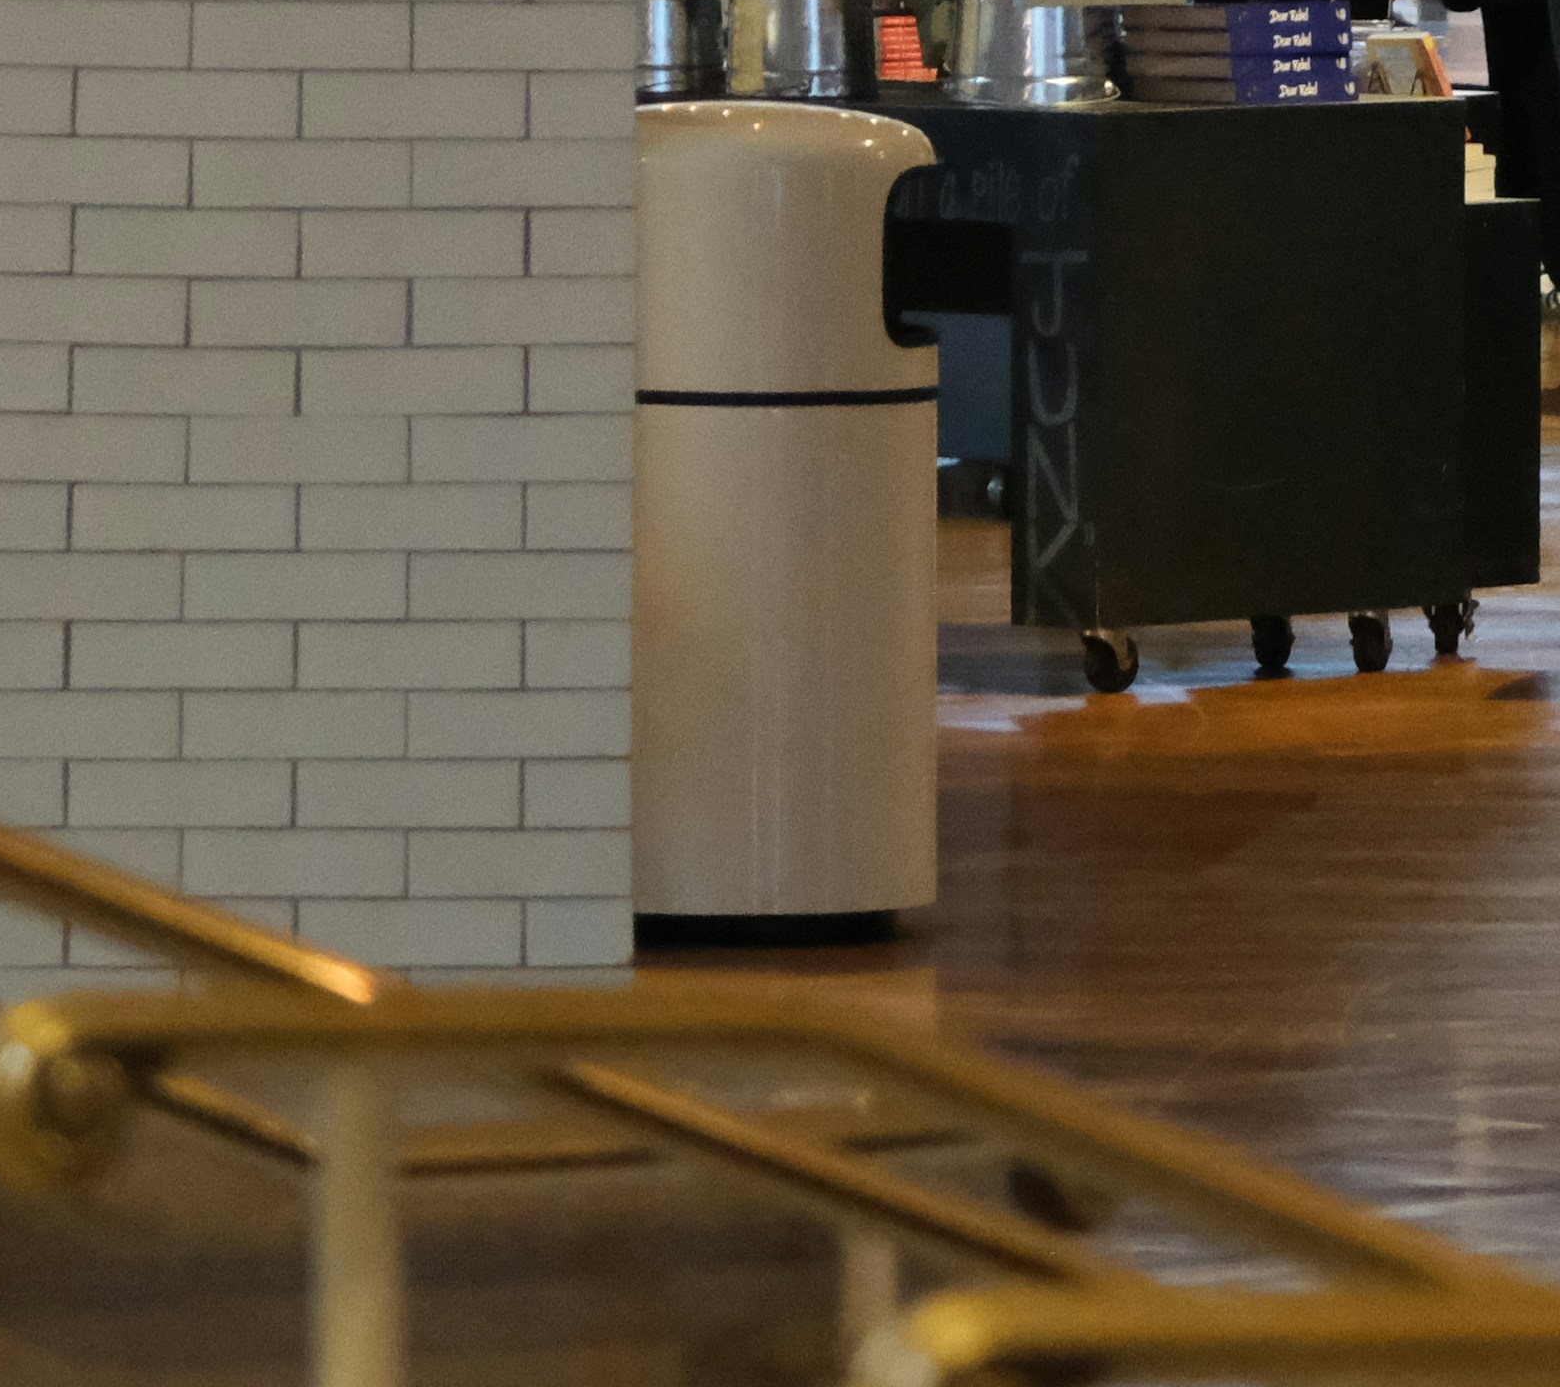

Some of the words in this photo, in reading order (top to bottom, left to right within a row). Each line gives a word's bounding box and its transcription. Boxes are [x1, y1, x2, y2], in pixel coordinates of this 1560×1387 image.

[1269, 8, 1289, 24] Dear
[1272, 34, 1292, 49] Dear
[1272, 59, 1292, 74] Dear
[1278, 84, 1298, 99] Dear
